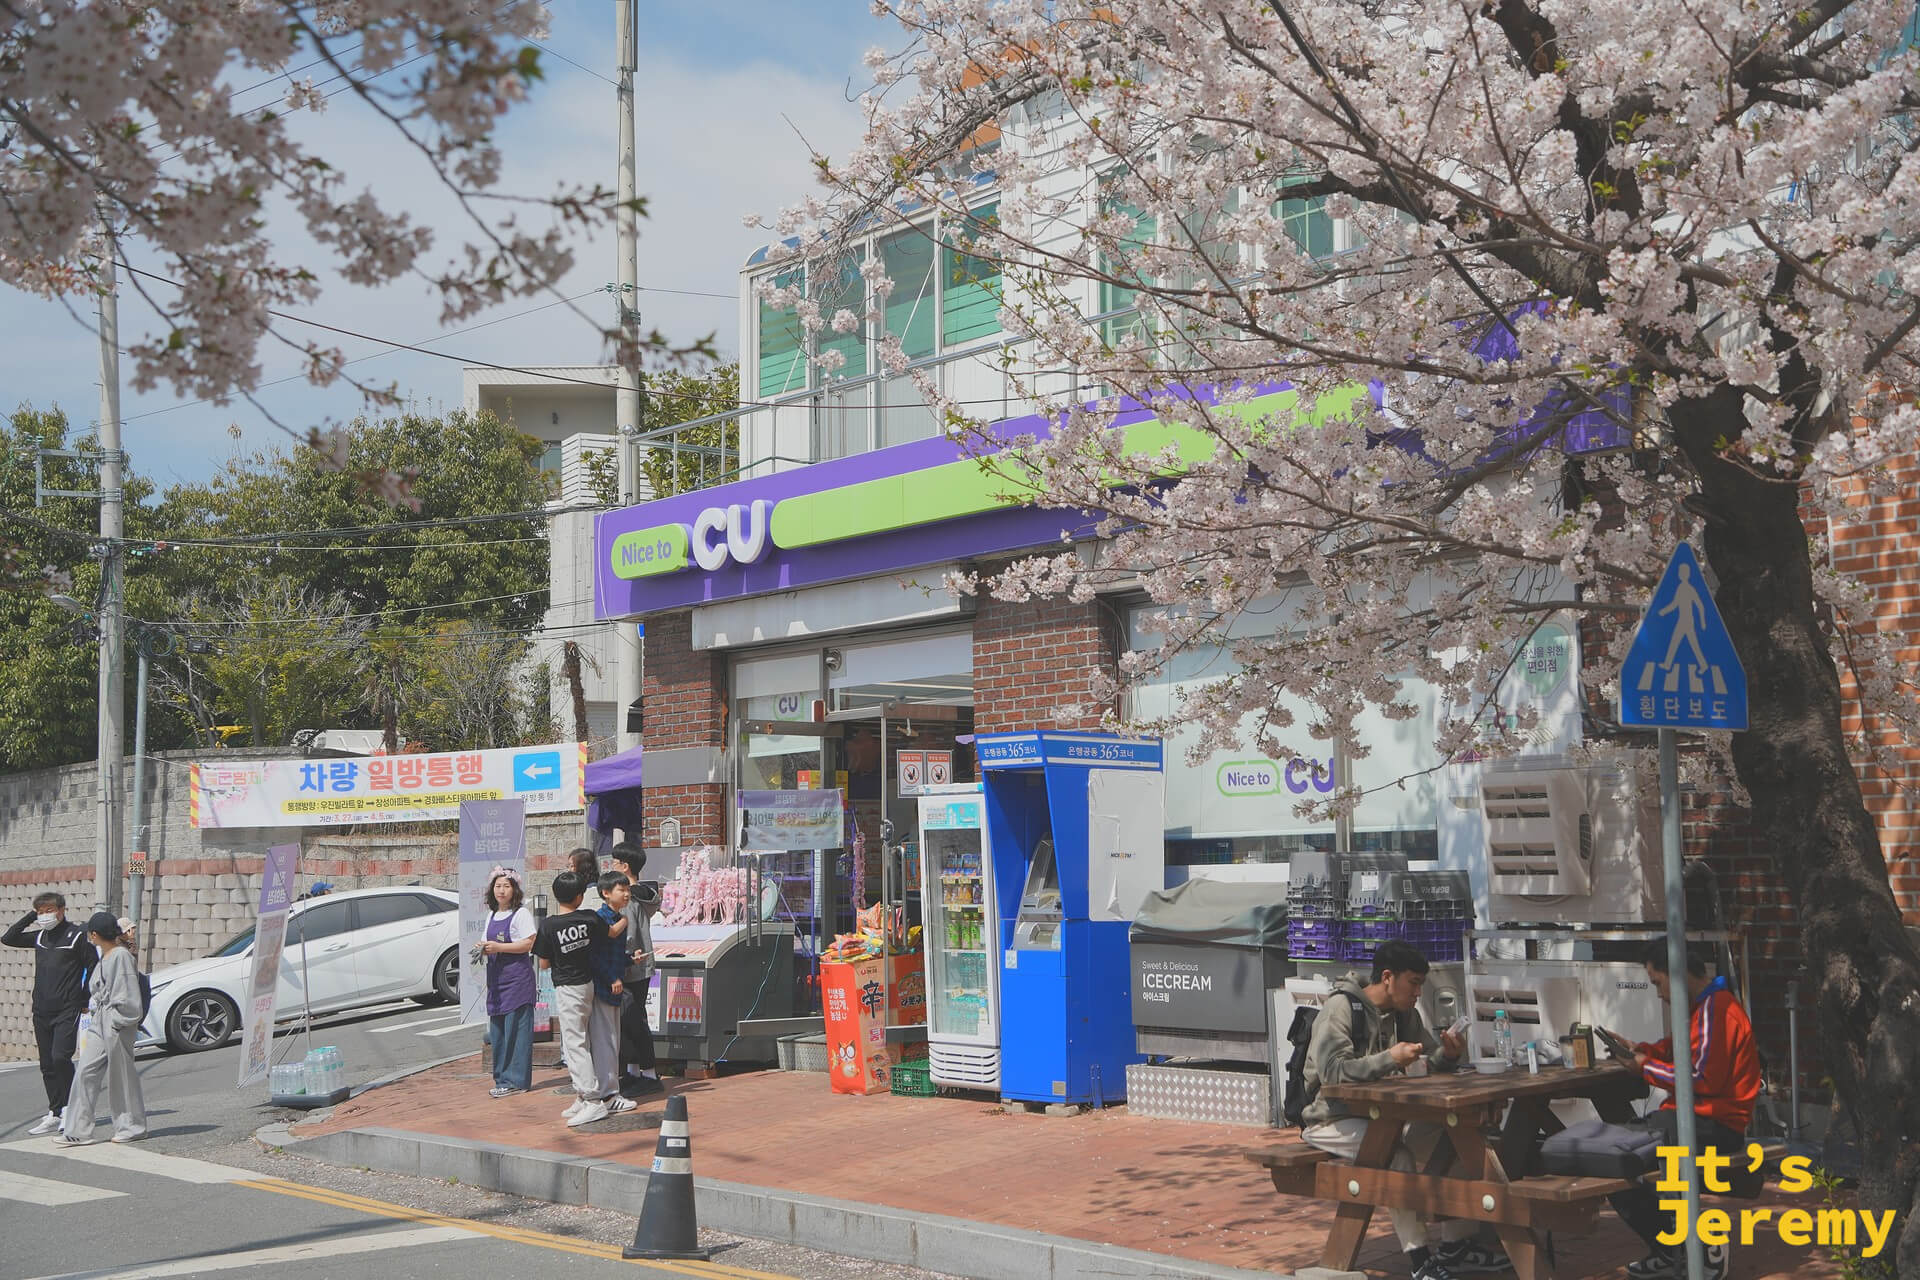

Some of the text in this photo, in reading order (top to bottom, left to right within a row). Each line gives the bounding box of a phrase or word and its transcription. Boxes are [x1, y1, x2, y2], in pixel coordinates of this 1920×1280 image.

[622, 499, 766, 572] Nice to CU
[1547, 645, 1563, 657] 위한
[1527, 659, 1557, 674] 편의점
[778, 695, 798, 714] CU
[1640, 695, 1728, 720] 횡단보도
[299, 753, 483, 793] 차량 일방통행
[1227, 757, 1335, 794] Nice to CU
[557, 924, 588, 944] KOR
[1142, 960, 1199, 972] Sweet & Delicious
[1142, 973, 1212, 992] ICECREAM
[861, 980, 884, 1020] 辛
[1142, 992, 1170, 1003] 아이스크림
